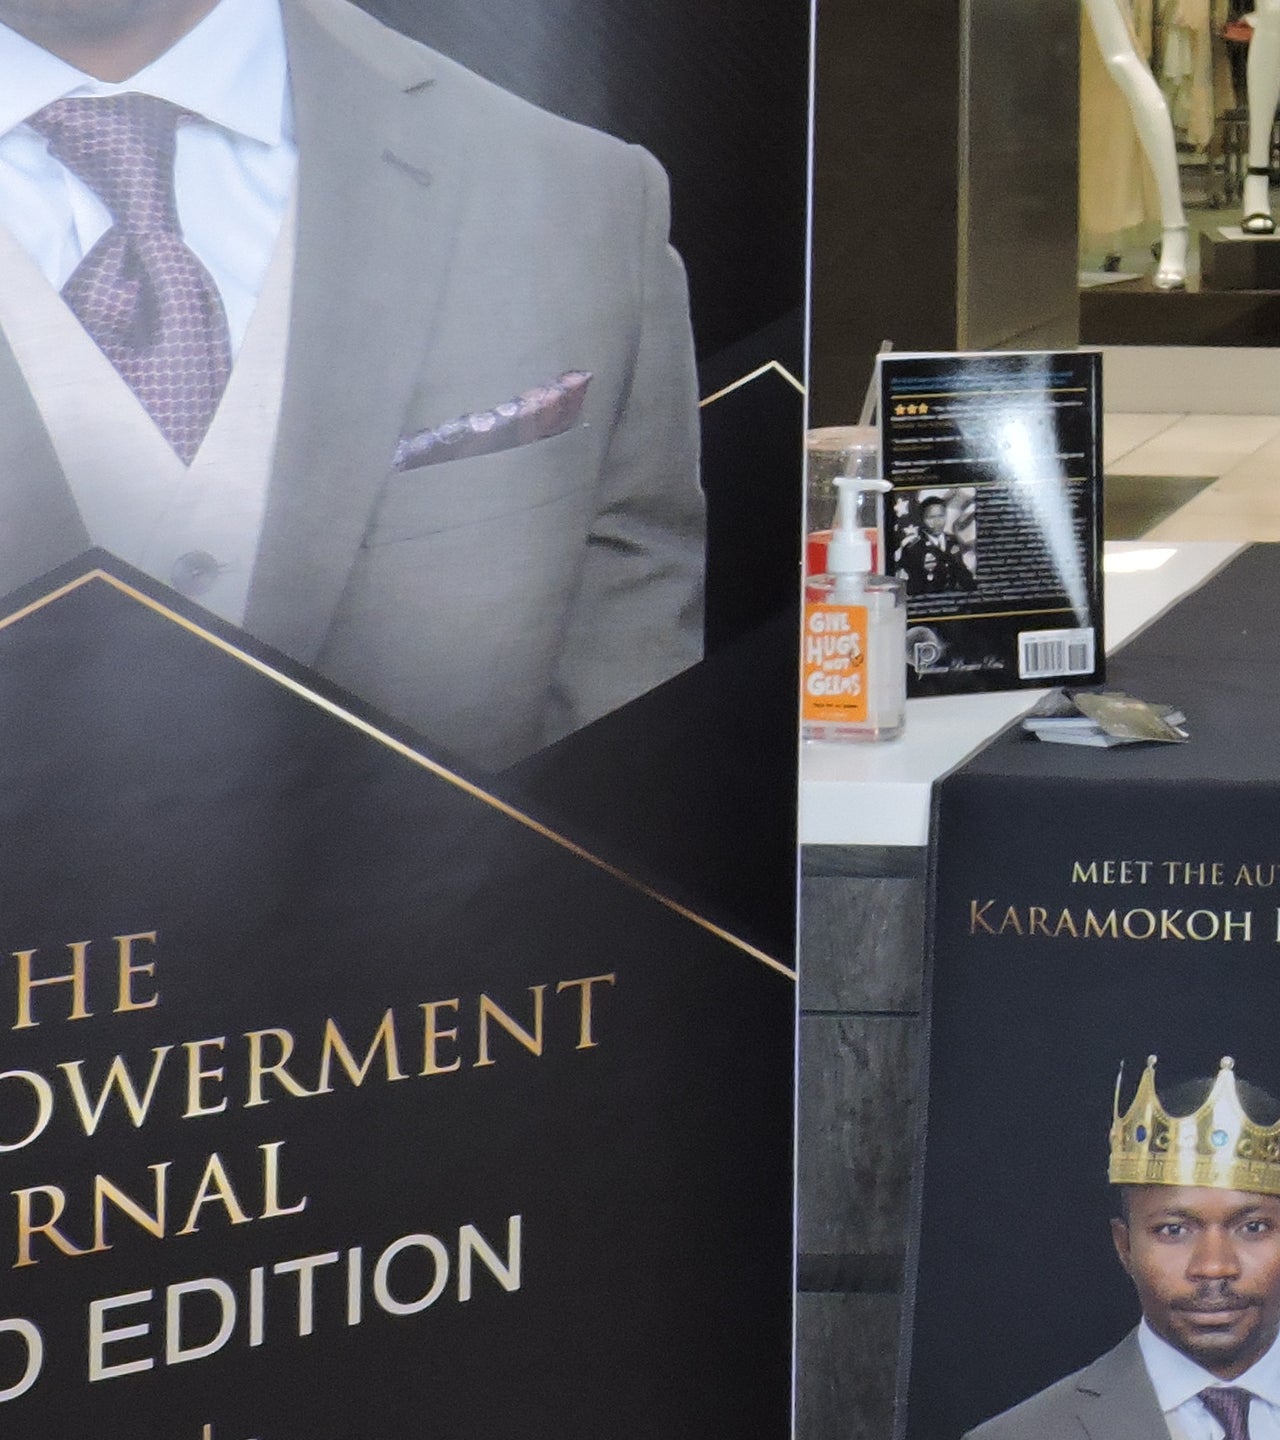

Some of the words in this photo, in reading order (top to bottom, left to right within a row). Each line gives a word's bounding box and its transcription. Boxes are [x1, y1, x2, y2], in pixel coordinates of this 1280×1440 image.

[807, 632, 860, 666] HUGS
[1072, 860, 1153, 885] MEET
[1162, 861, 1225, 886] THE
[969, 900, 1253, 942] KARAMOKOH
[12, 1141, 308, 1268] RNAL
[89, 1215, 521, 1383] EDITION
